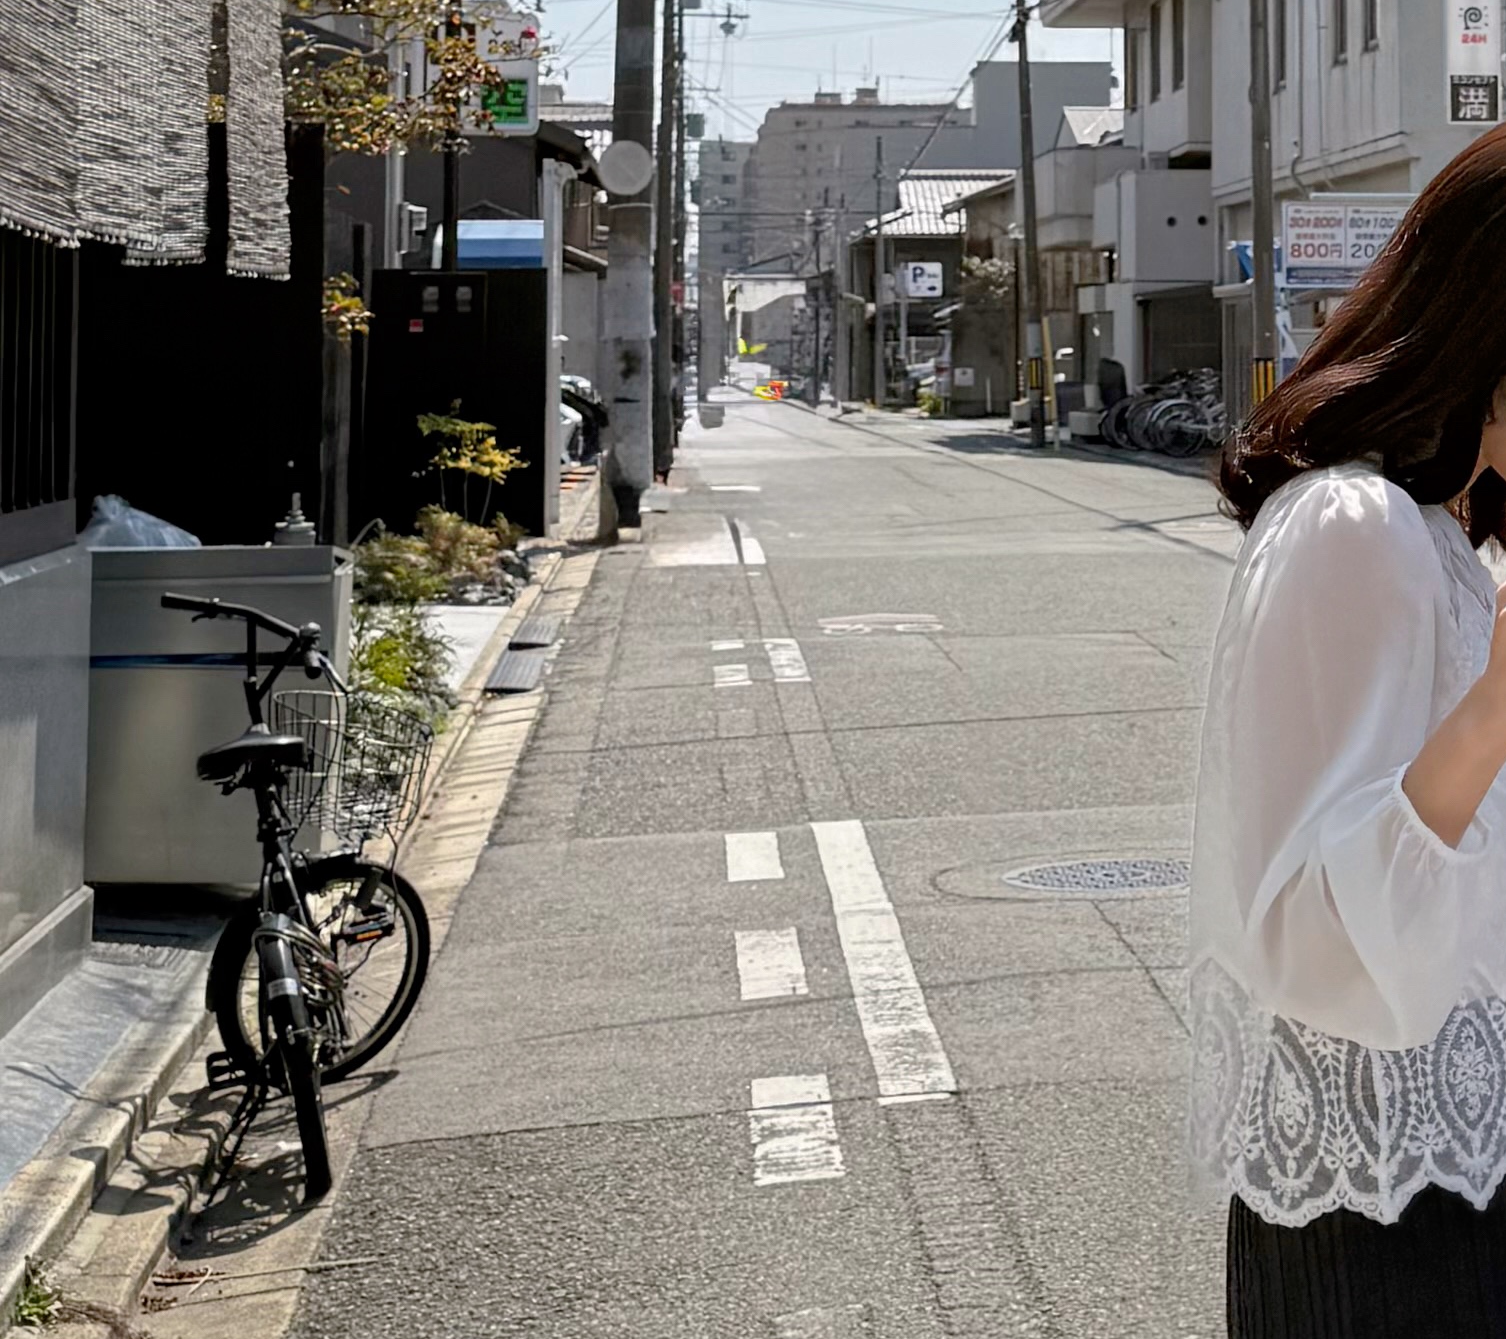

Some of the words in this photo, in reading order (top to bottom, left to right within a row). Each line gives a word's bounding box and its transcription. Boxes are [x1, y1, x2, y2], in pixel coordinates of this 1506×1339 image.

[1458, 87, 1489, 119] 満
[1290, 243, 1343, 259] 800円
[912, 265, 924, 283] P
